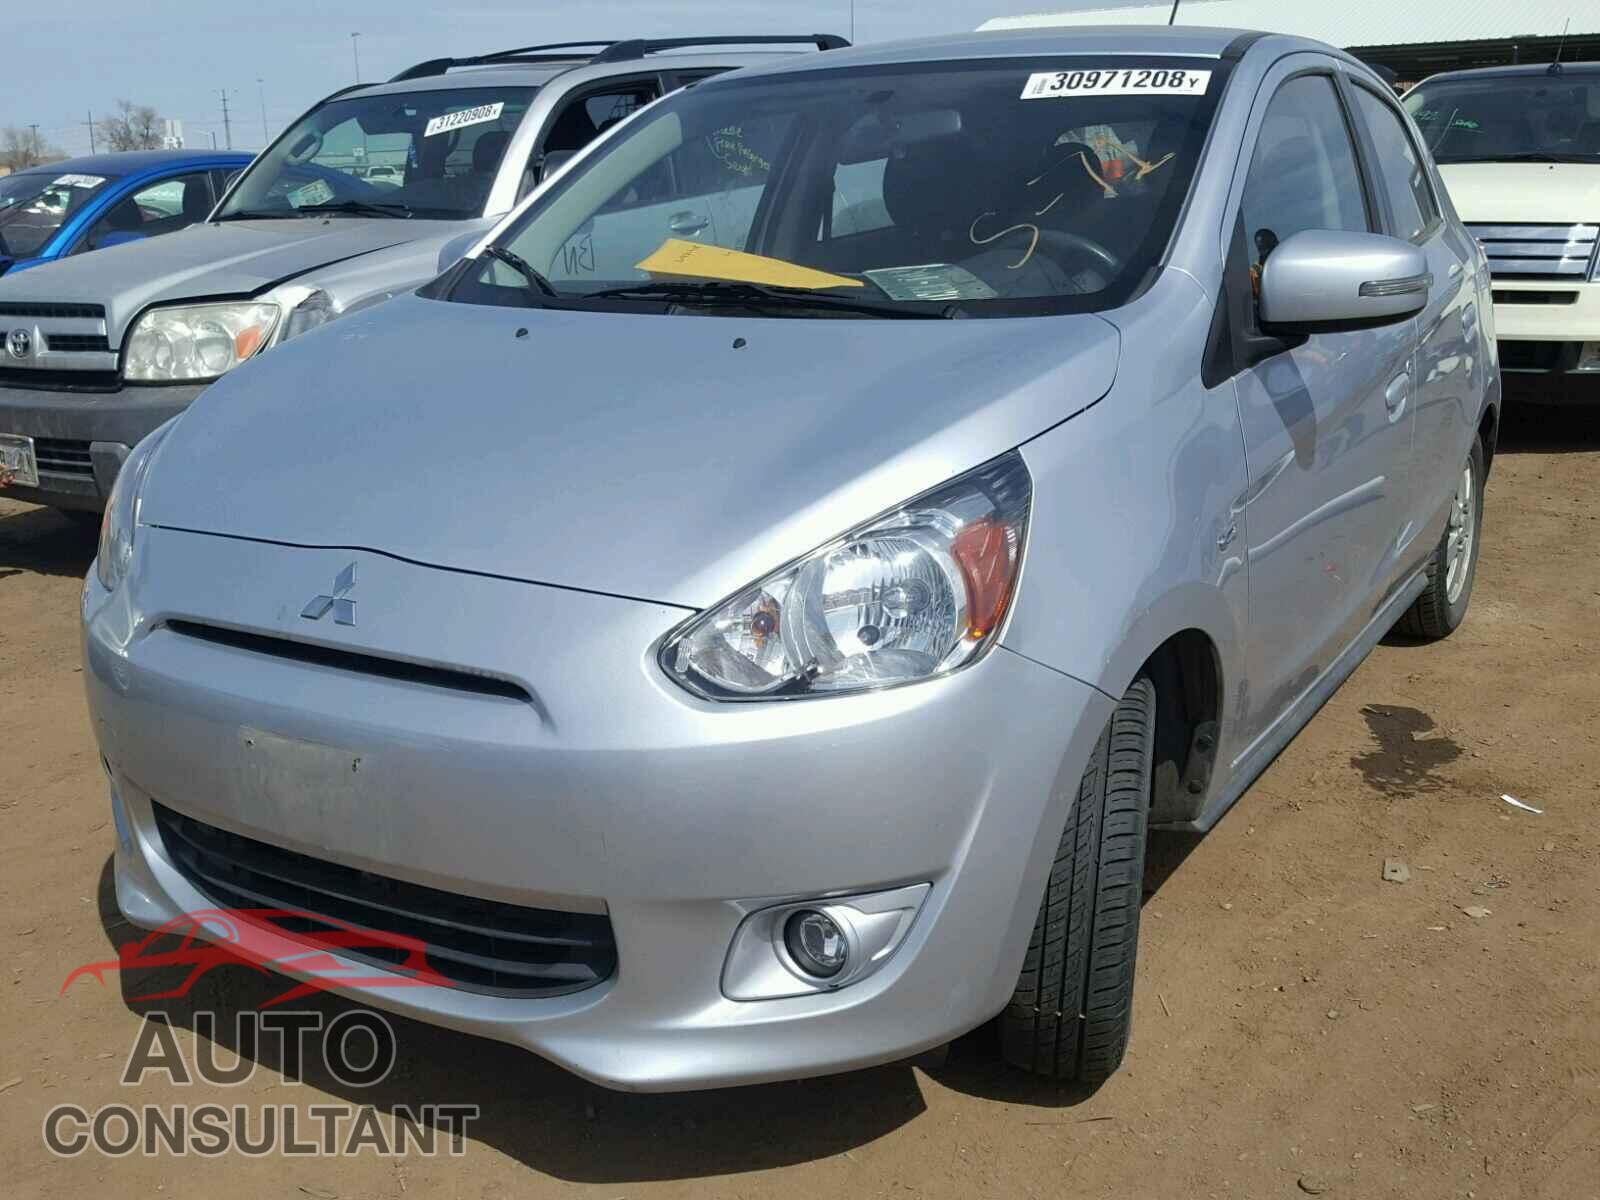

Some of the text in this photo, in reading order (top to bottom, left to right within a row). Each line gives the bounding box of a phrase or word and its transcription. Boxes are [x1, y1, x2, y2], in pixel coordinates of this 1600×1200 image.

[1050, 70, 1186, 91] 30971208
[1189, 77, 1199, 88] Y
[436, 106, 493, 129] 31220908
